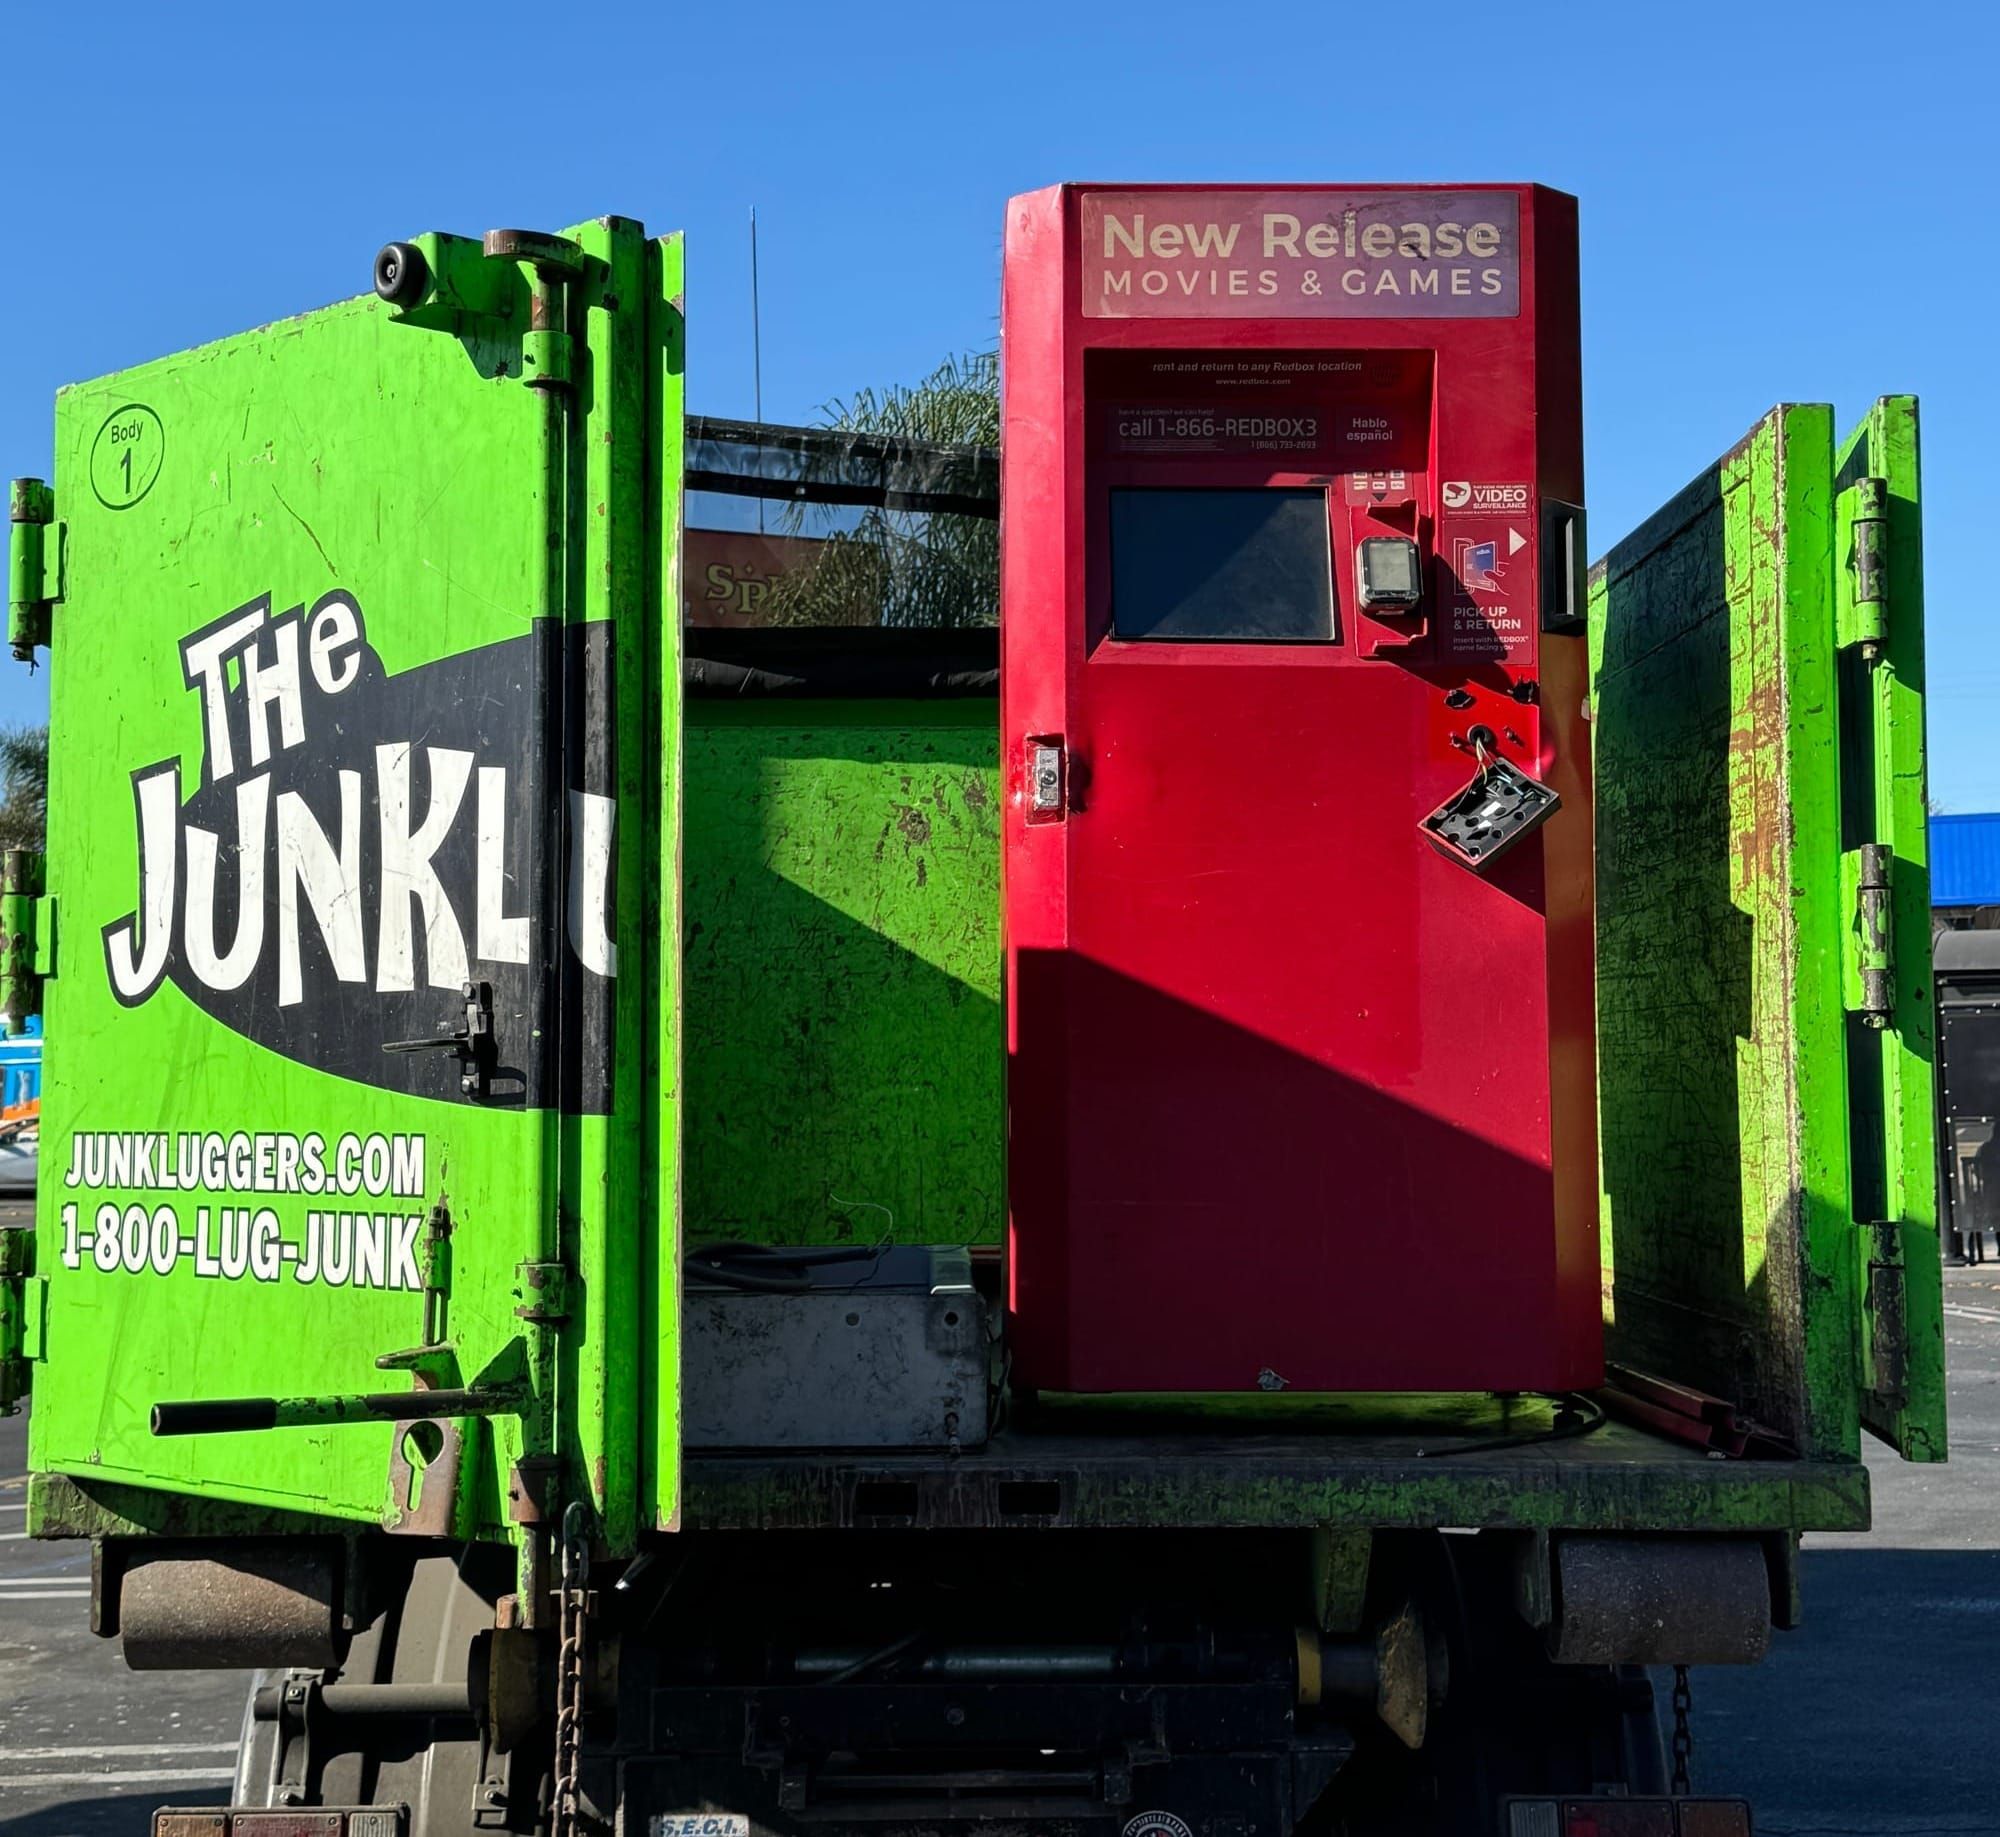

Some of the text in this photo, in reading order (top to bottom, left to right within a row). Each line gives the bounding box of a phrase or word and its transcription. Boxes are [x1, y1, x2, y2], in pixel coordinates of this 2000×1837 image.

[1103, 211, 1501, 259] New Release
[1103, 268, 1502, 296] MOVIES & GAMES
[1152, 361, 1362, 373] rent and return to any Redbox location
[111, 419, 144, 444] Body
[1119, 418, 1317, 437] call 1-866-REDBOX3
[1352, 417, 1388, 428] Hablo
[1346, 429, 1393, 443] español
[120, 447, 132, 494] 1
[1473, 489, 1527, 502] VIDEO
[1453, 606, 1508, 617] PICK UP
[1453, 619, 1521, 630] & RETURN
[64, 1131, 426, 1198] JUNKLUGGERS.COM
[61, 1201, 425, 1292] 1-800-LUG-JUNK
